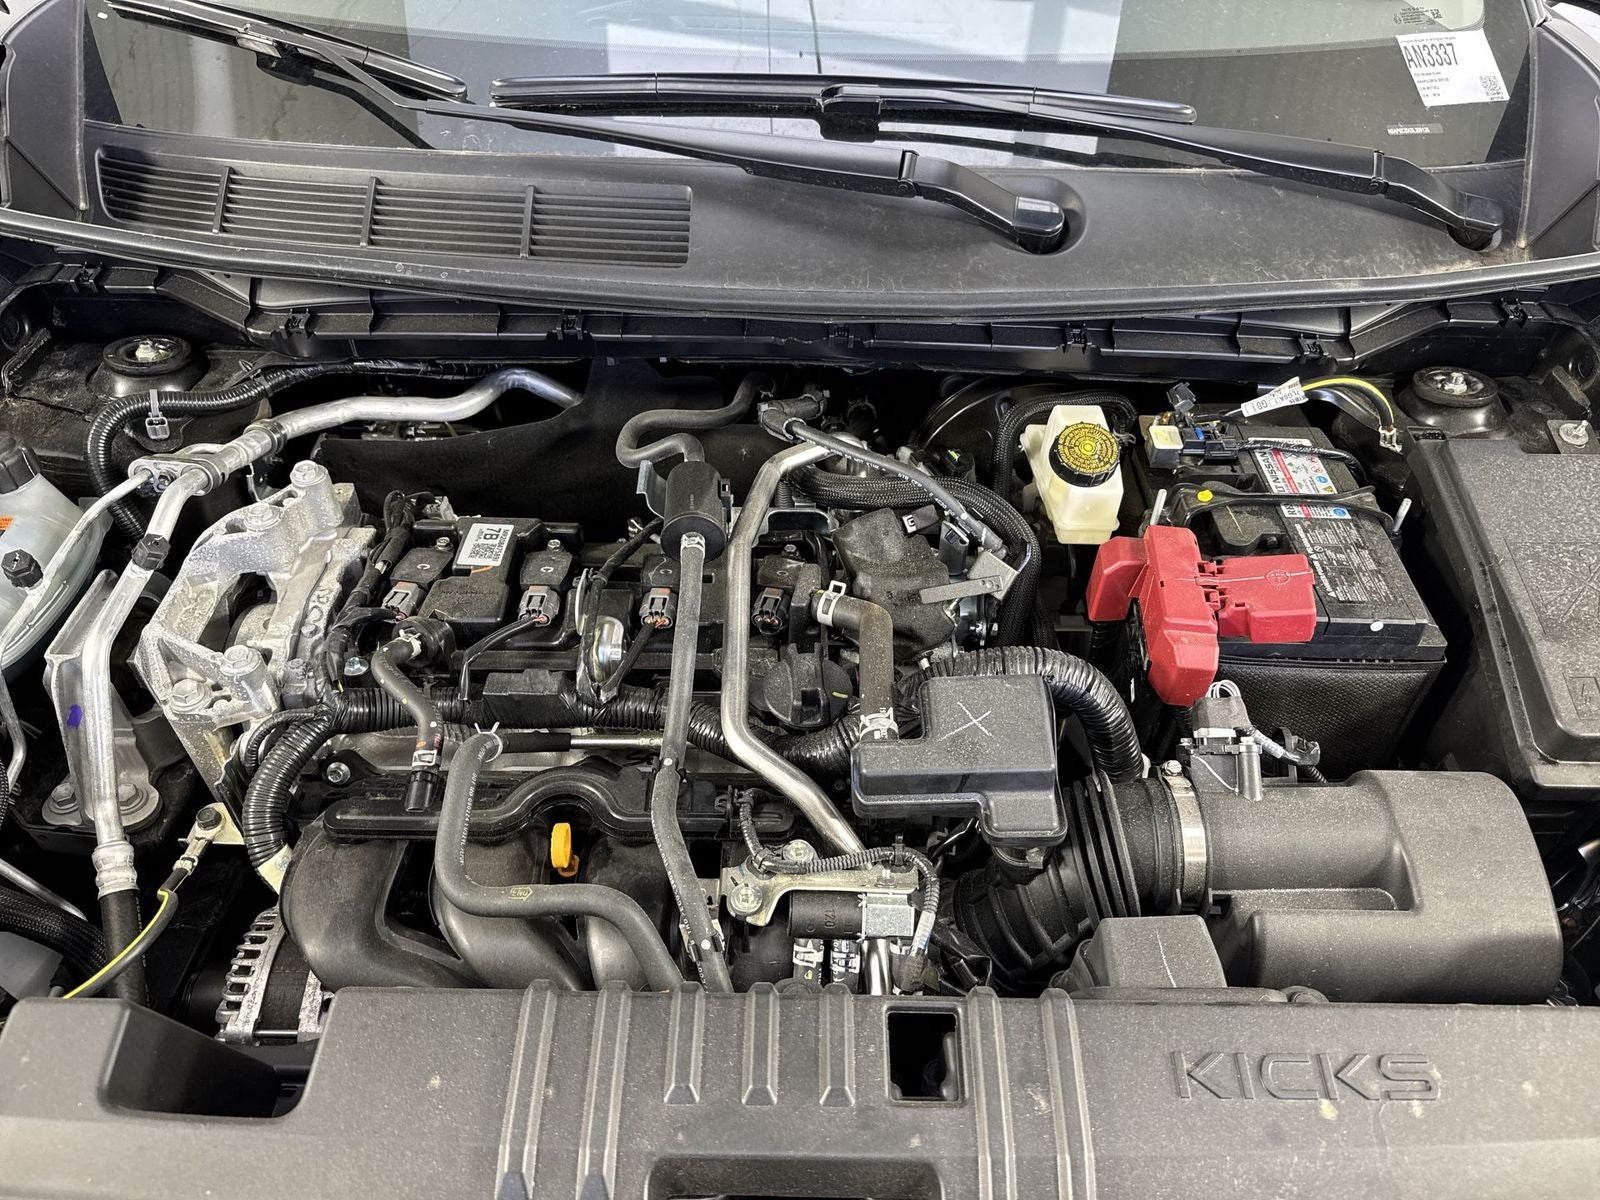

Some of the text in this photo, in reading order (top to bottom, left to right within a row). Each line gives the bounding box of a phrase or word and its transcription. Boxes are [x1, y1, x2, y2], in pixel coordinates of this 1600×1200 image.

[1403, 43, 1458, 68] AN3337
[1259, 451, 1281, 485] NISSAN
[483, 527, 502, 542] 7B
[1170, 1050, 1441, 1101] KICKS
